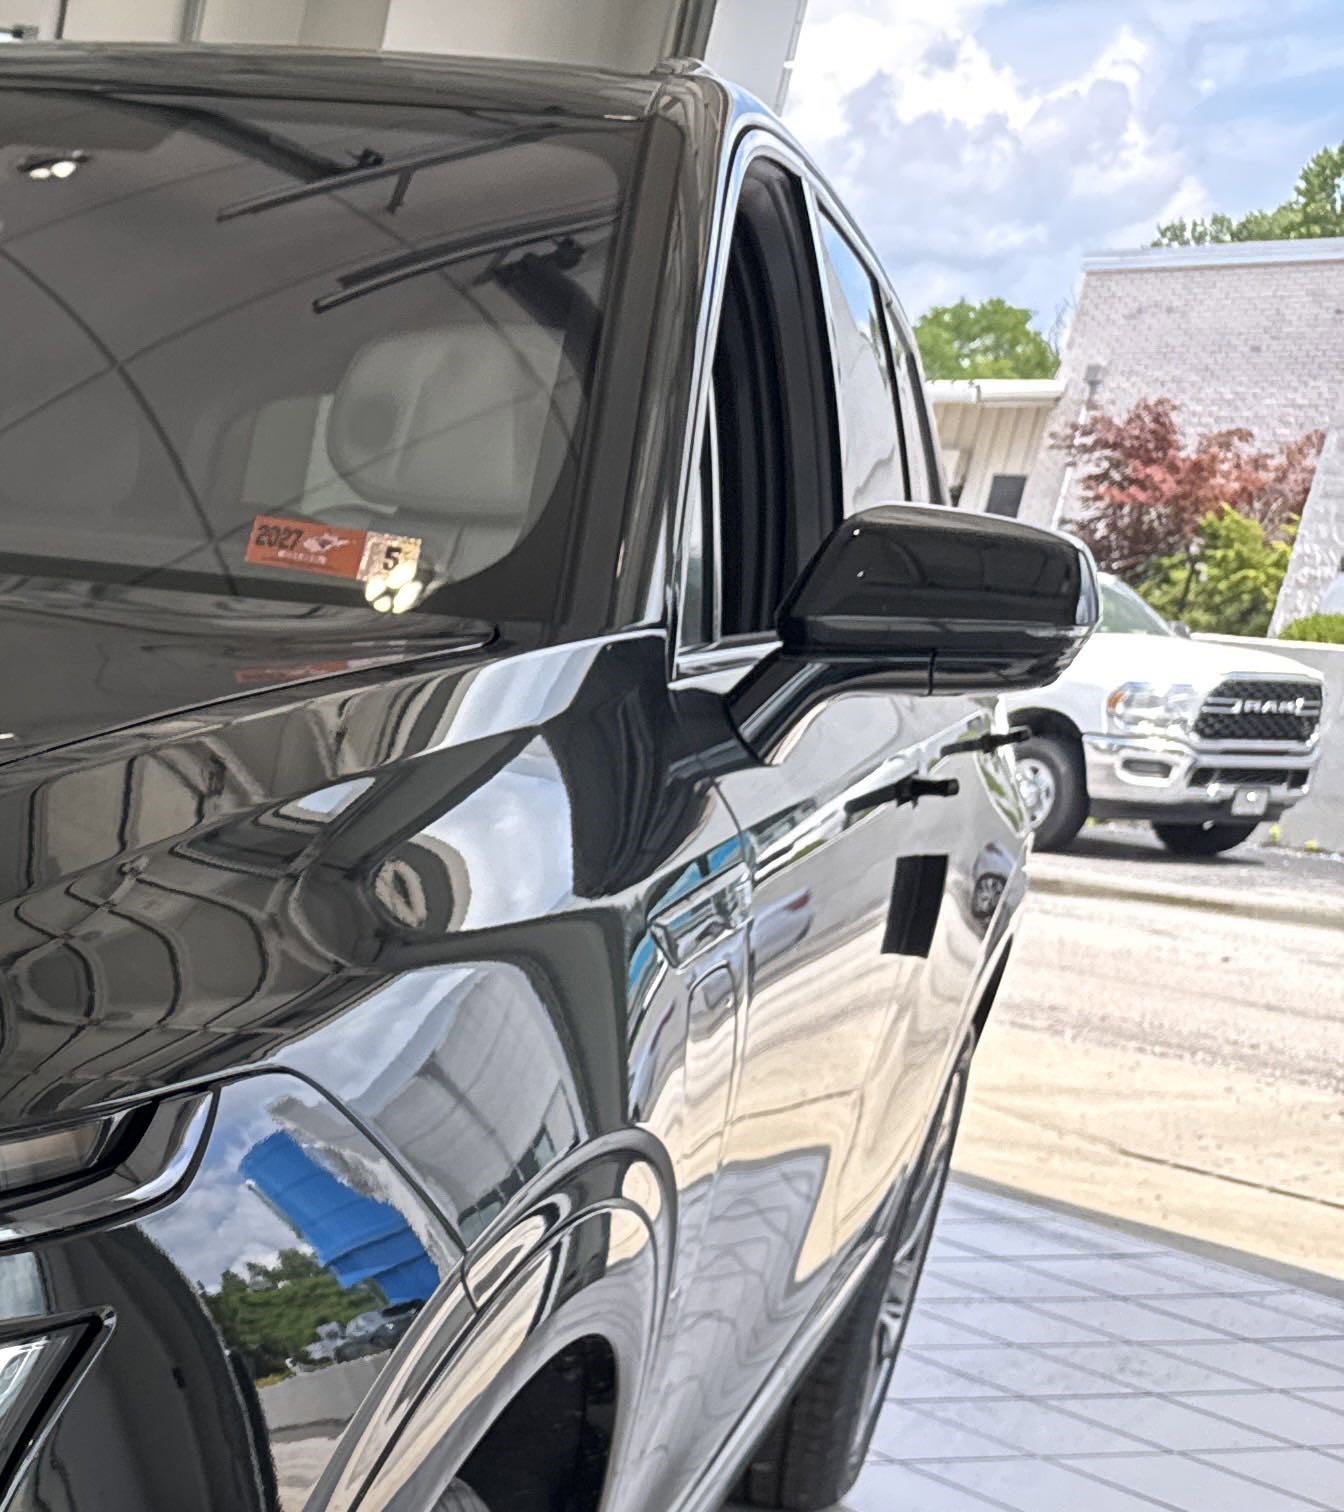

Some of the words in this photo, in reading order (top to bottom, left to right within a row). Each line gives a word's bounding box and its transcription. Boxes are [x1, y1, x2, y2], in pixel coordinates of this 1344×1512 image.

[255, 524, 304, 551] 2027
[382, 546, 402, 570] 5
[1243, 700, 1296, 714] RAM
